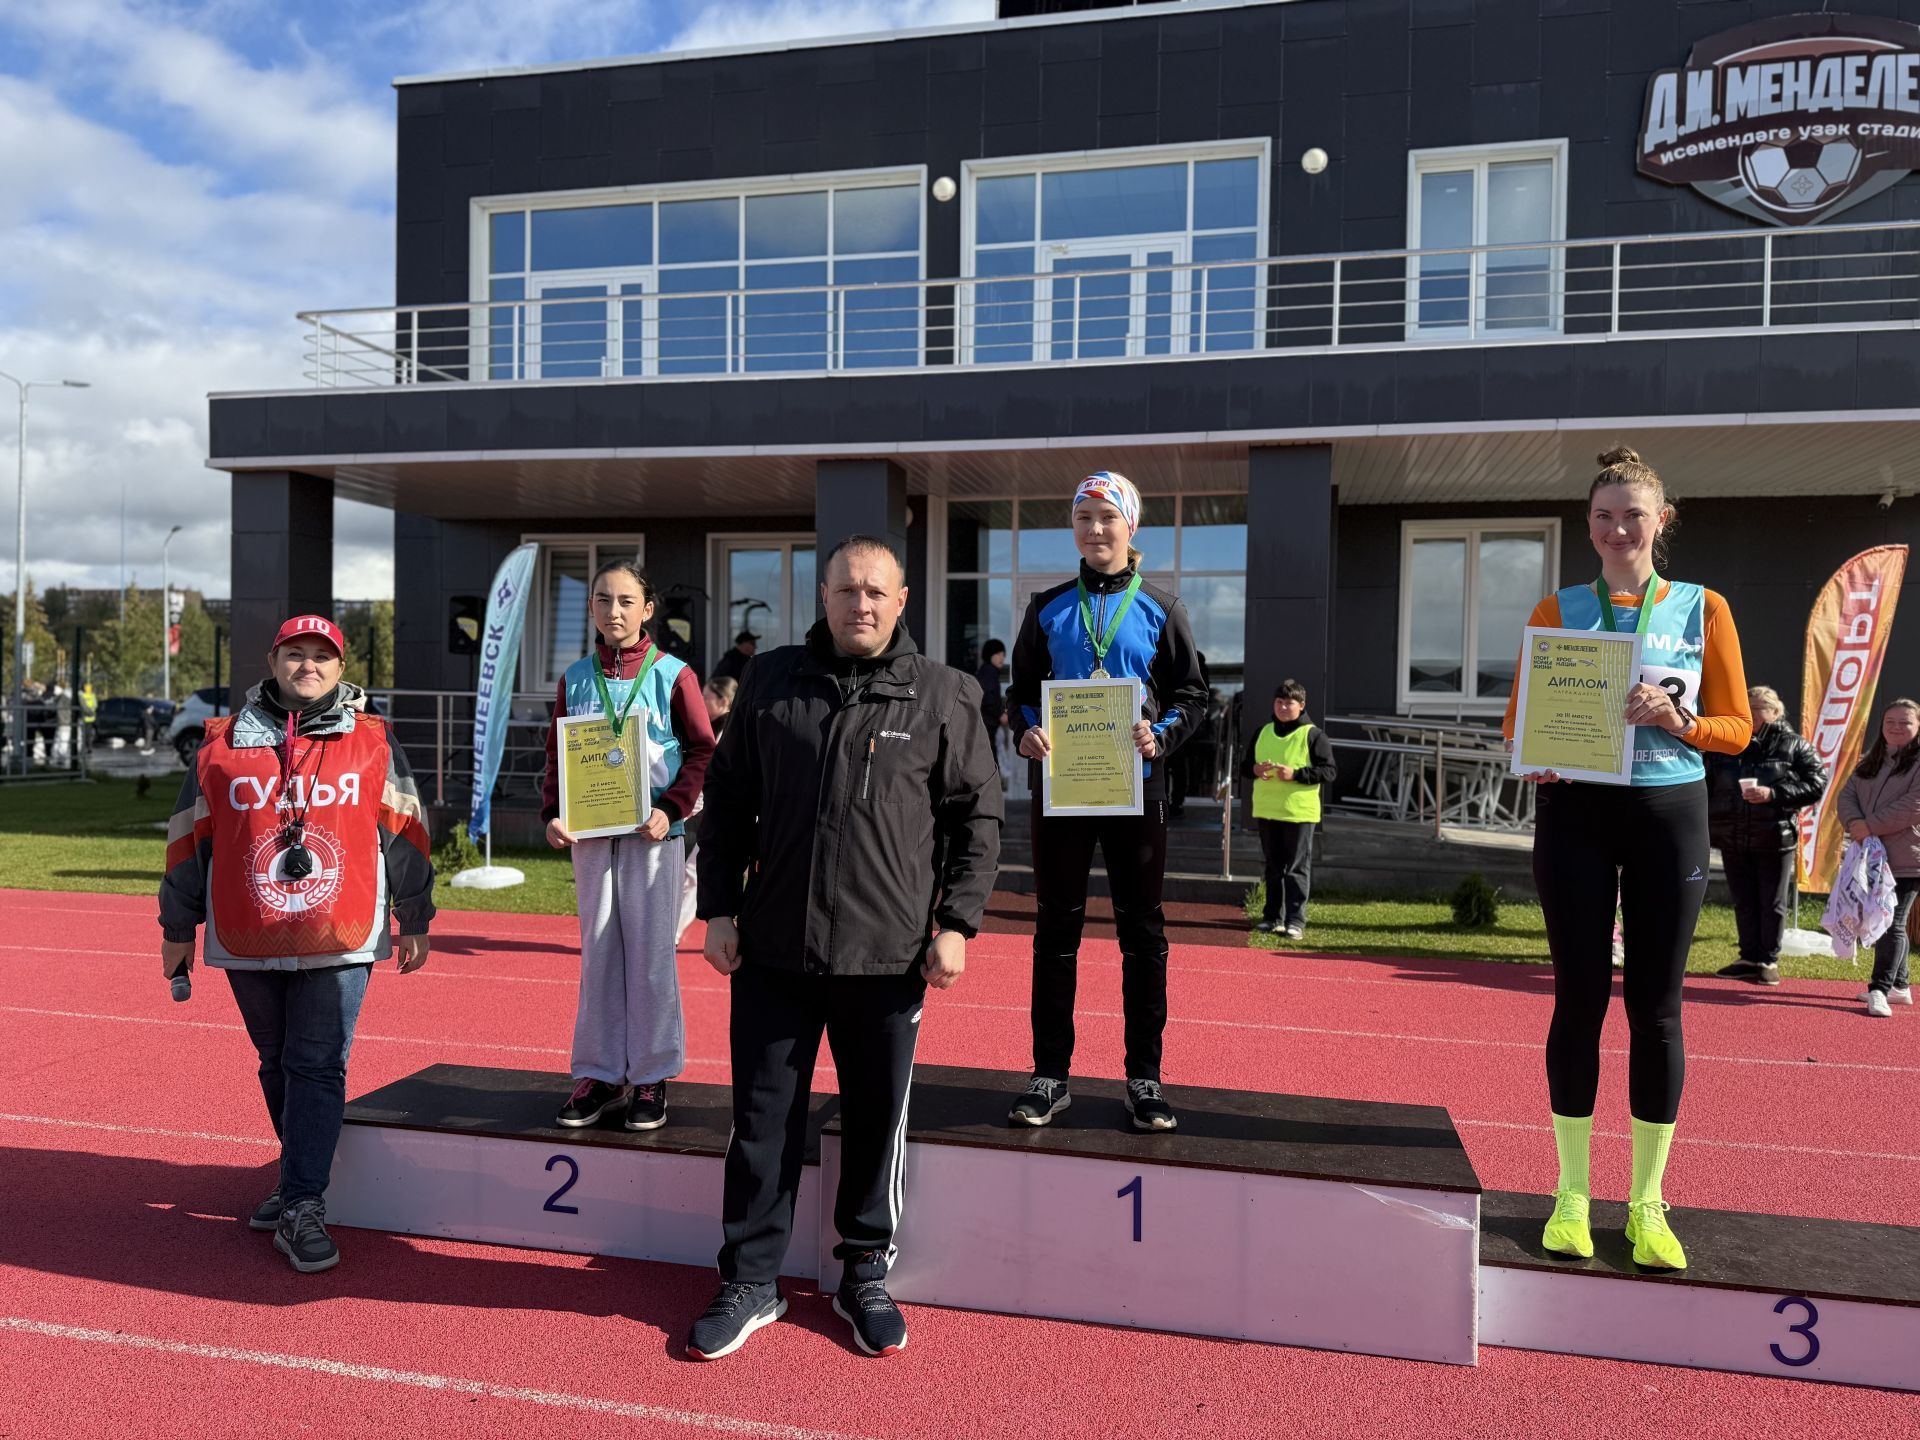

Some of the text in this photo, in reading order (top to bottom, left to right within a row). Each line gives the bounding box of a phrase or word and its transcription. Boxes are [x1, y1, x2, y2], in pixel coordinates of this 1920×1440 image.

[1644, 70, 1720, 153] Д.И.
[1660, 125, 1791, 165] исемендәге
[297, 618, 330, 634] ГТО
[1547, 676, 1608, 690] ДИПЛОМ
[1065, 721, 1116, 734] ДИПЛОМ
[580, 753, 608, 765] ДИПЛ
[229, 773, 360, 813] СУДЬЯ
[283, 880, 310, 891] ГТО
[543, 1155, 579, 1215] 2
[1117, 1176, 1142, 1242] 1
[1769, 1296, 1820, 1367] 3
